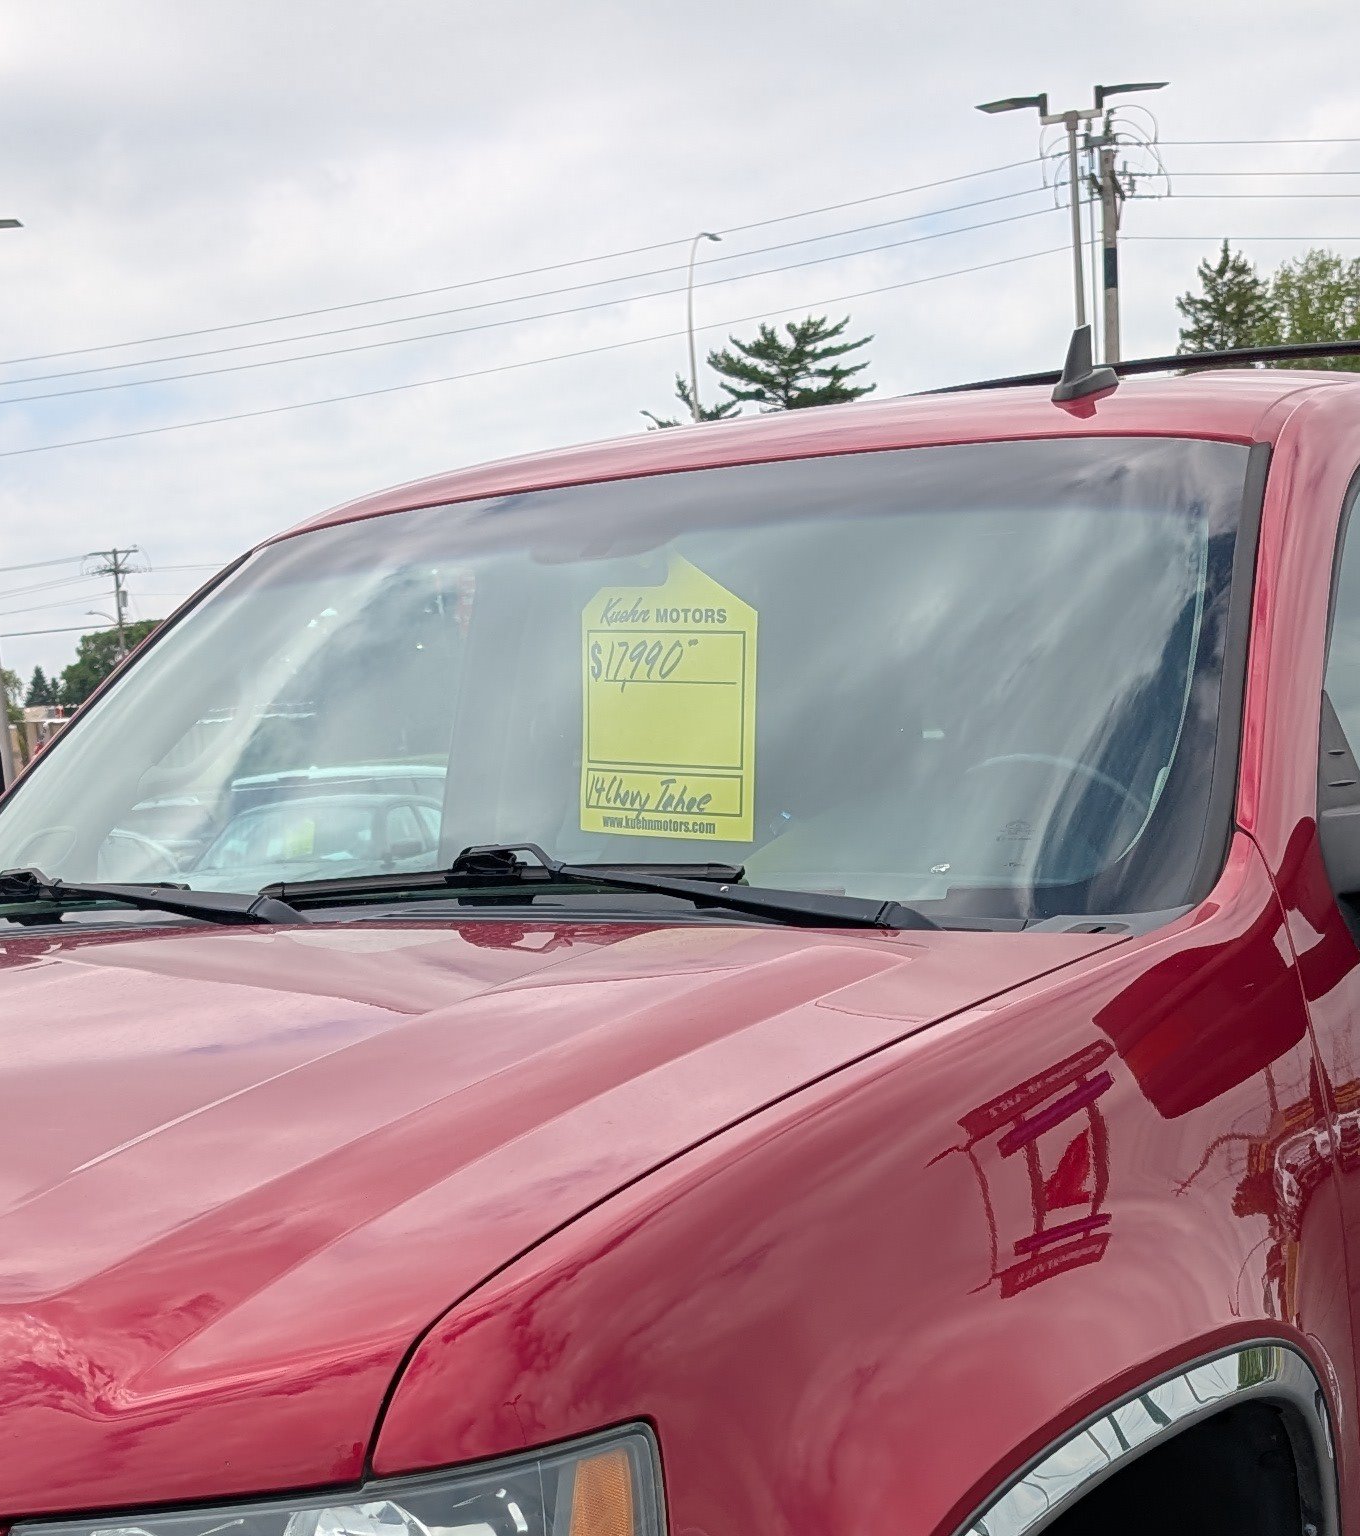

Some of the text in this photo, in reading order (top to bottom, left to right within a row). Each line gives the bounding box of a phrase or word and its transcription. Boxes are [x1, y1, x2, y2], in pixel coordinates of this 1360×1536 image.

[600, 597, 727, 626] Kuehn MOTORS
[654, 778, 712, 813] Tahoe
[602, 815, 716, 834] www.kuehnmotors.com
